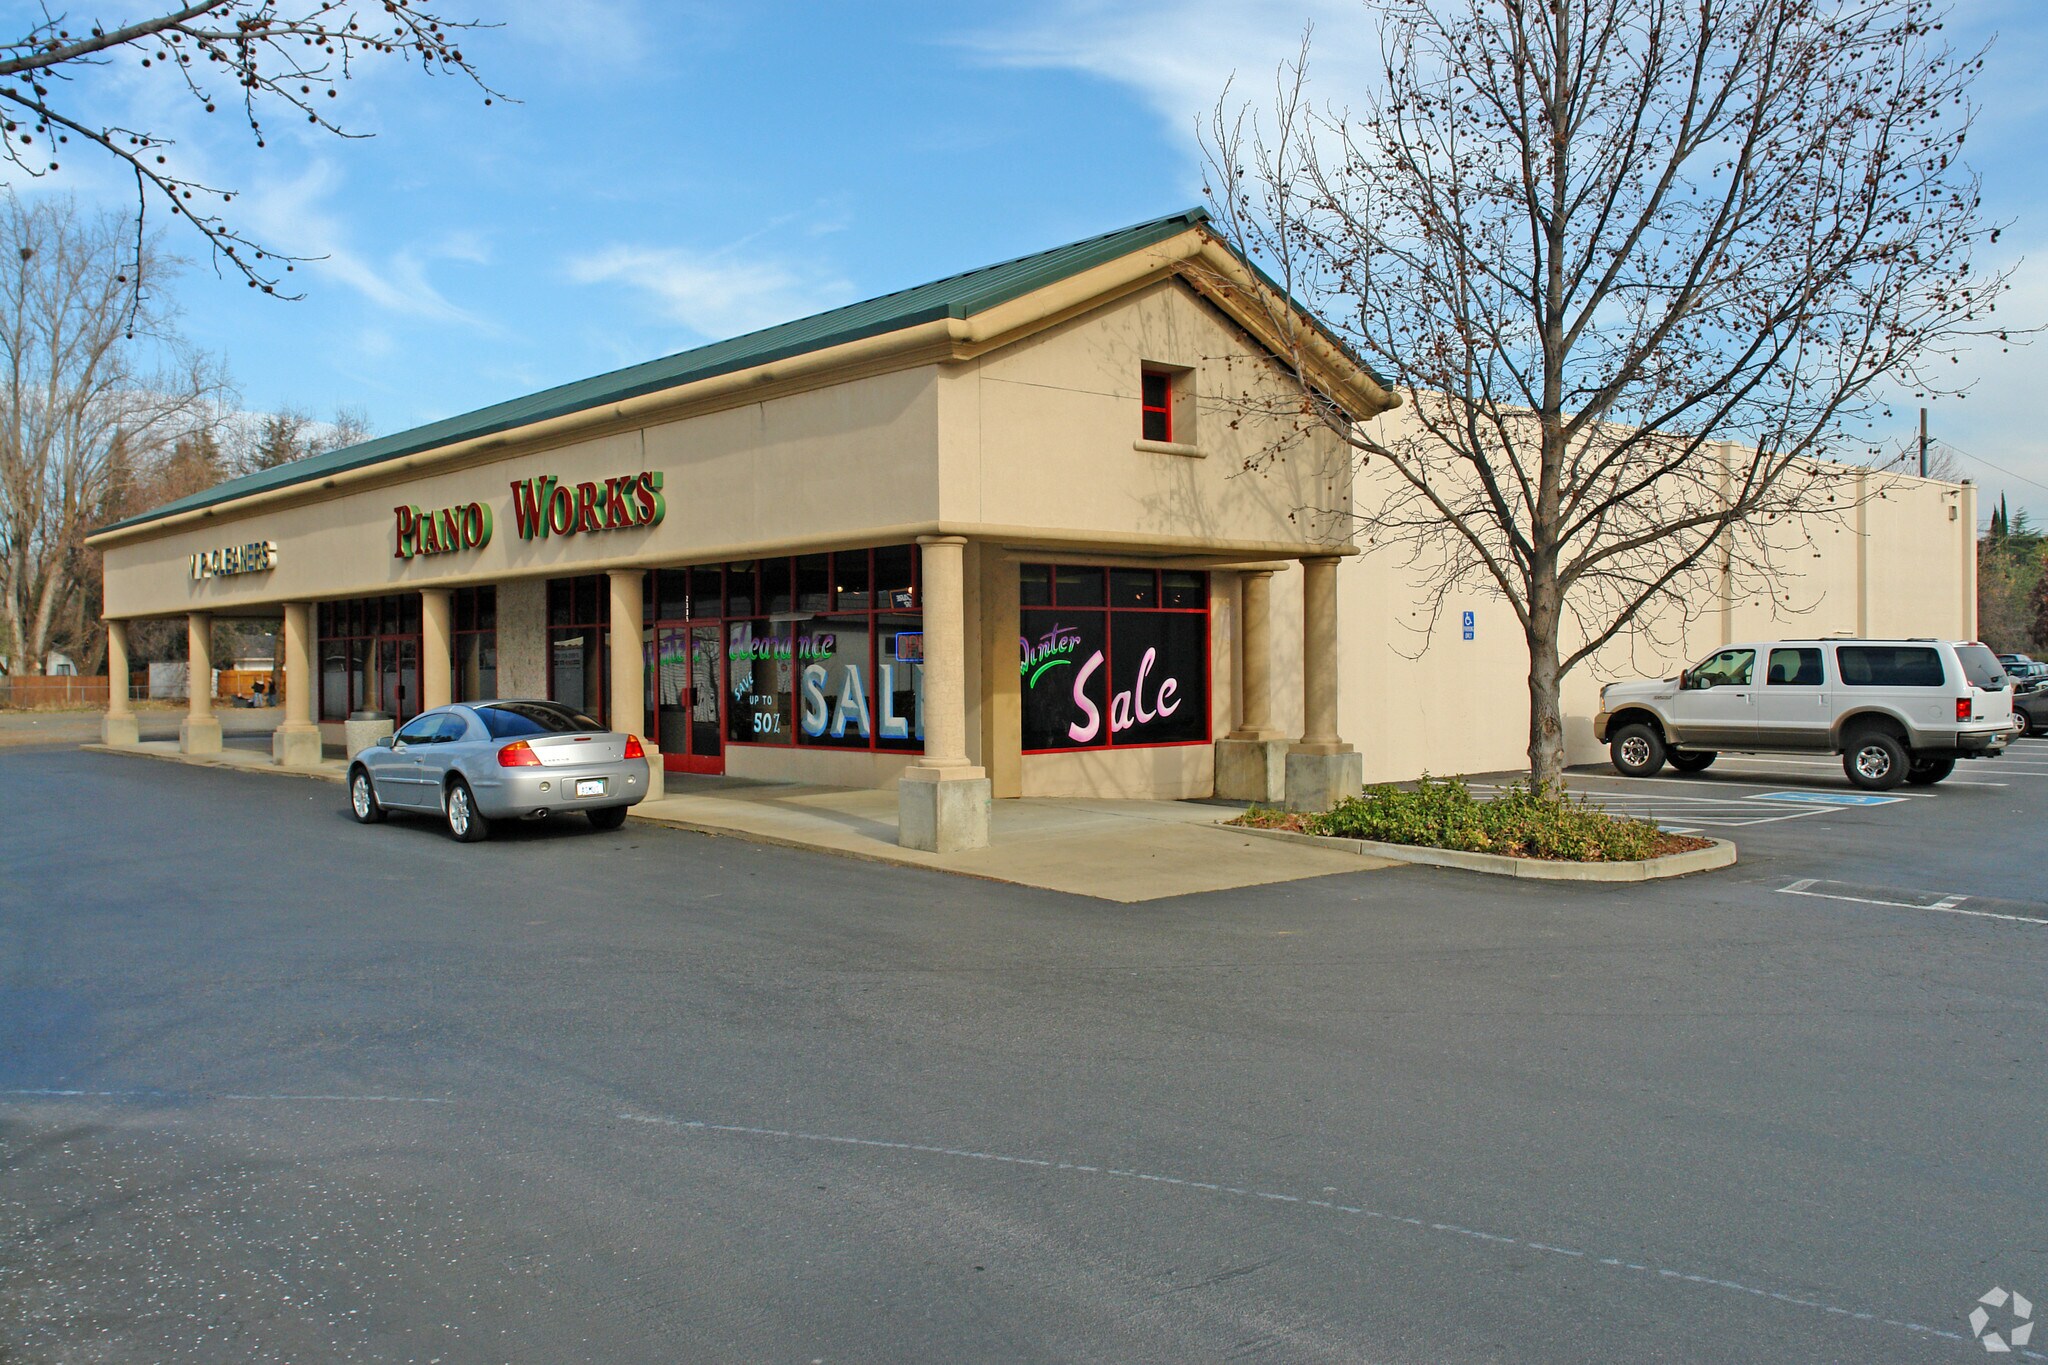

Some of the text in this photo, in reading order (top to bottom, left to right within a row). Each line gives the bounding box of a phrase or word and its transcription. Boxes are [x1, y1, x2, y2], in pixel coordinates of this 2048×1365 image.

[394, 471, 666, 558] PIANO WORKS
[212, 541, 278, 576] CLEANERS
[729, 621, 834, 661] clearance
[898, 635, 924, 660] OP
[734, 671, 754, 701] SAVE
[749, 695, 772, 705] UP TO
[1068, 647, 1182, 743] Sale
